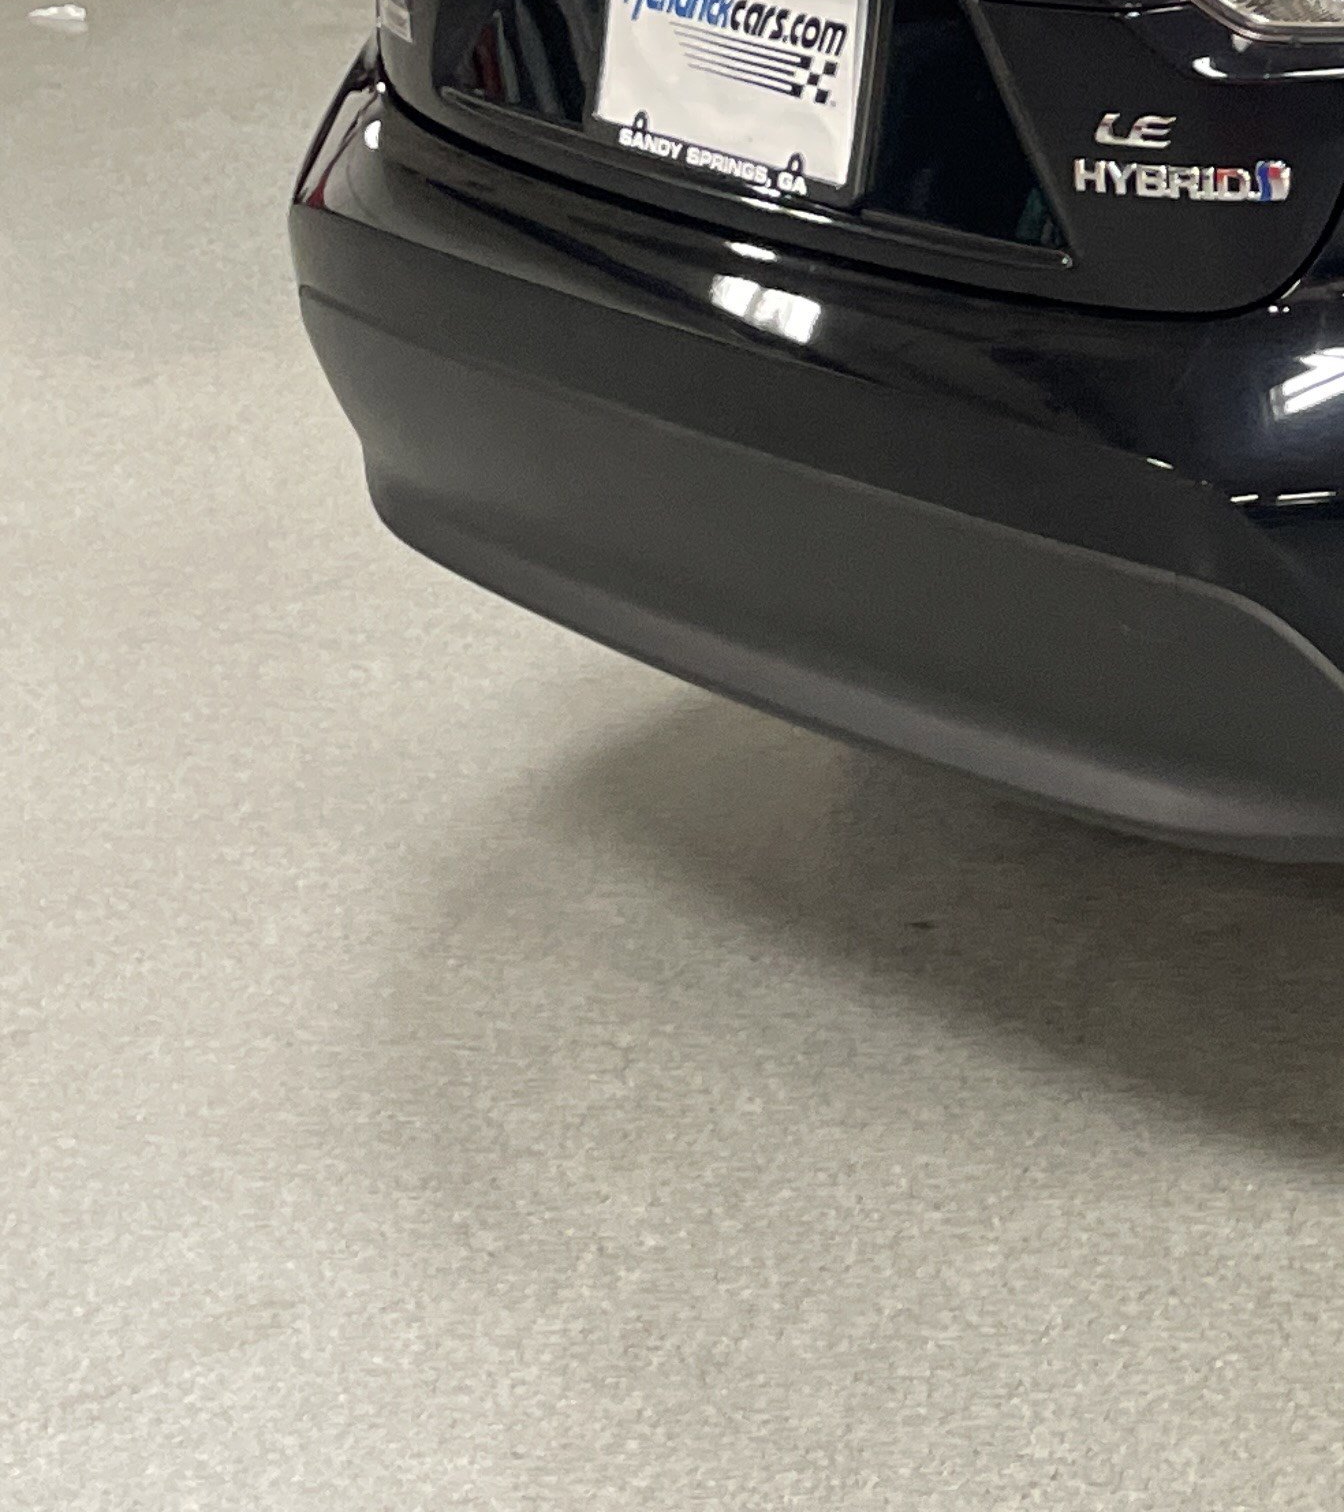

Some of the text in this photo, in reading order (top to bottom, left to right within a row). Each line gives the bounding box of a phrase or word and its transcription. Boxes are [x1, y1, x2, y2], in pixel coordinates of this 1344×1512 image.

[1094, 112, 1177, 149] LE
[618, 127, 807, 195] SANDY SPRINGS, GA
